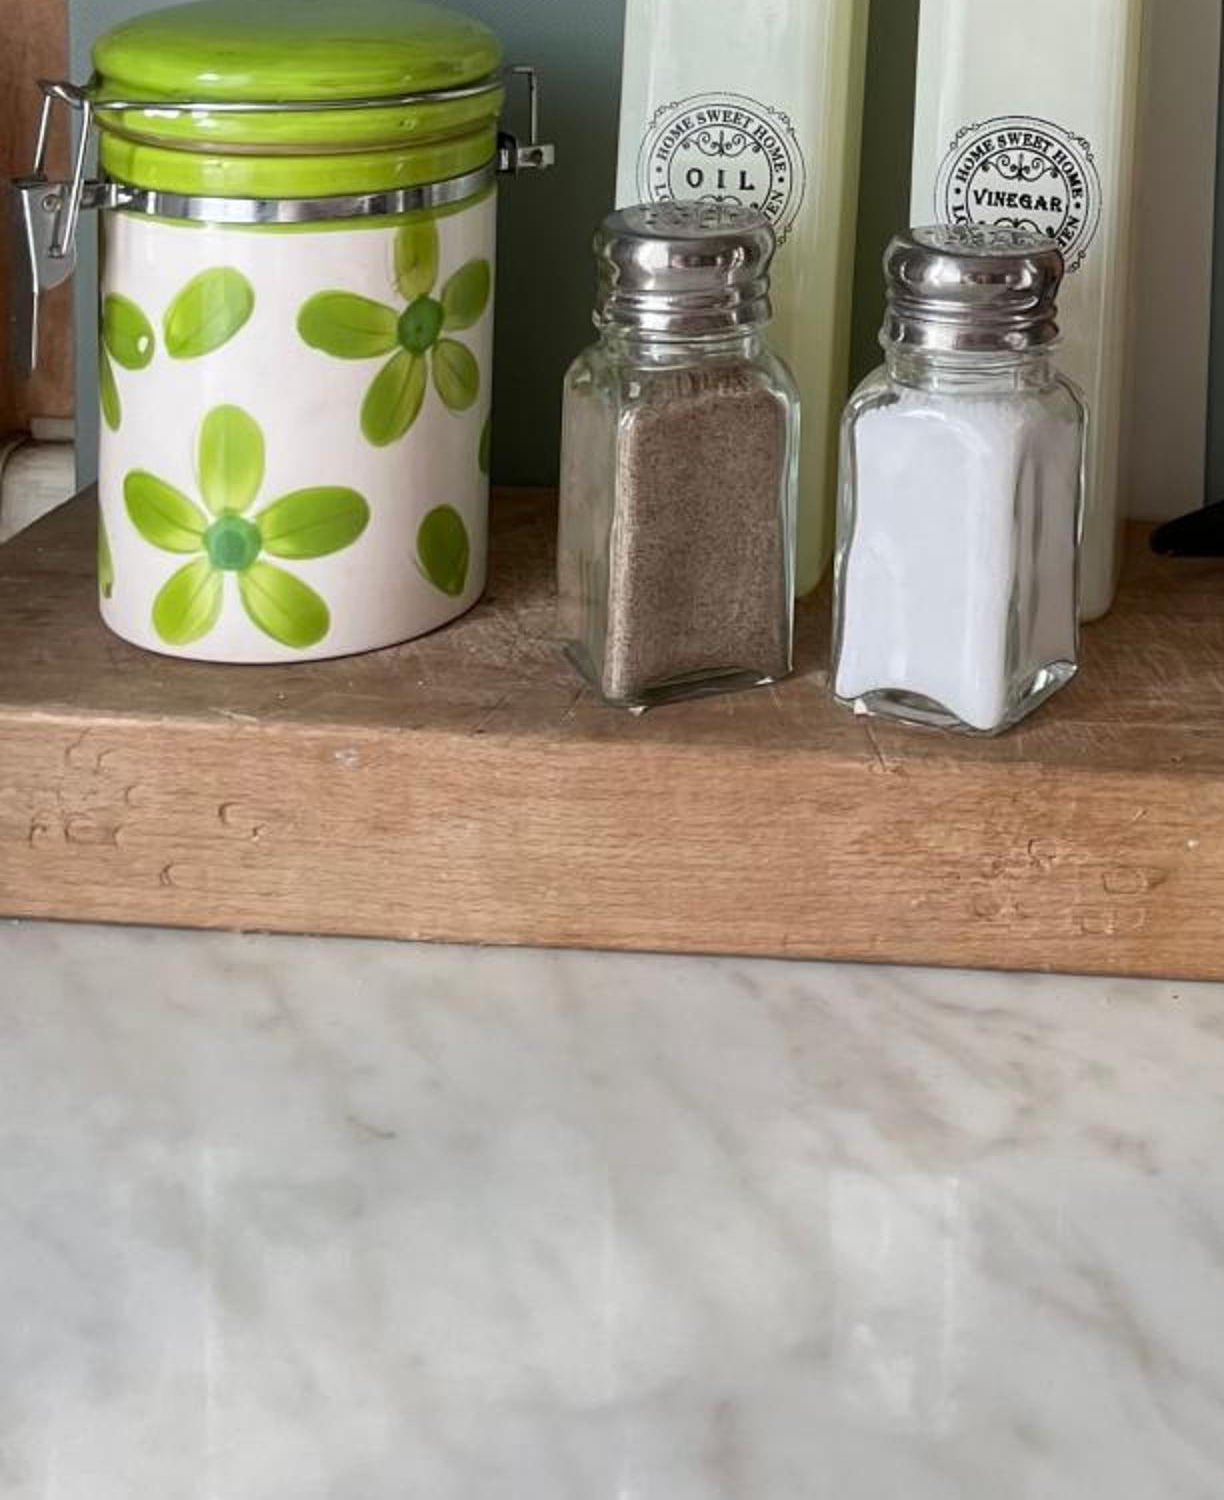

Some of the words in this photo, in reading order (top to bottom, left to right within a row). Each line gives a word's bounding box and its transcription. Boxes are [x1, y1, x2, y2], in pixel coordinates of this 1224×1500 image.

[655, 115, 695, 162] HOME
[696, 109, 755, 130] SWEET
[752, 122, 787, 174] HOME
[685, 167, 756, 191] OIL
[956, 138, 995, 184] HOME
[997, 131, 1054, 154] SWEET
[1052, 149, 1084, 199] HOME
[972, 187, 1063, 213] VINEGAR
